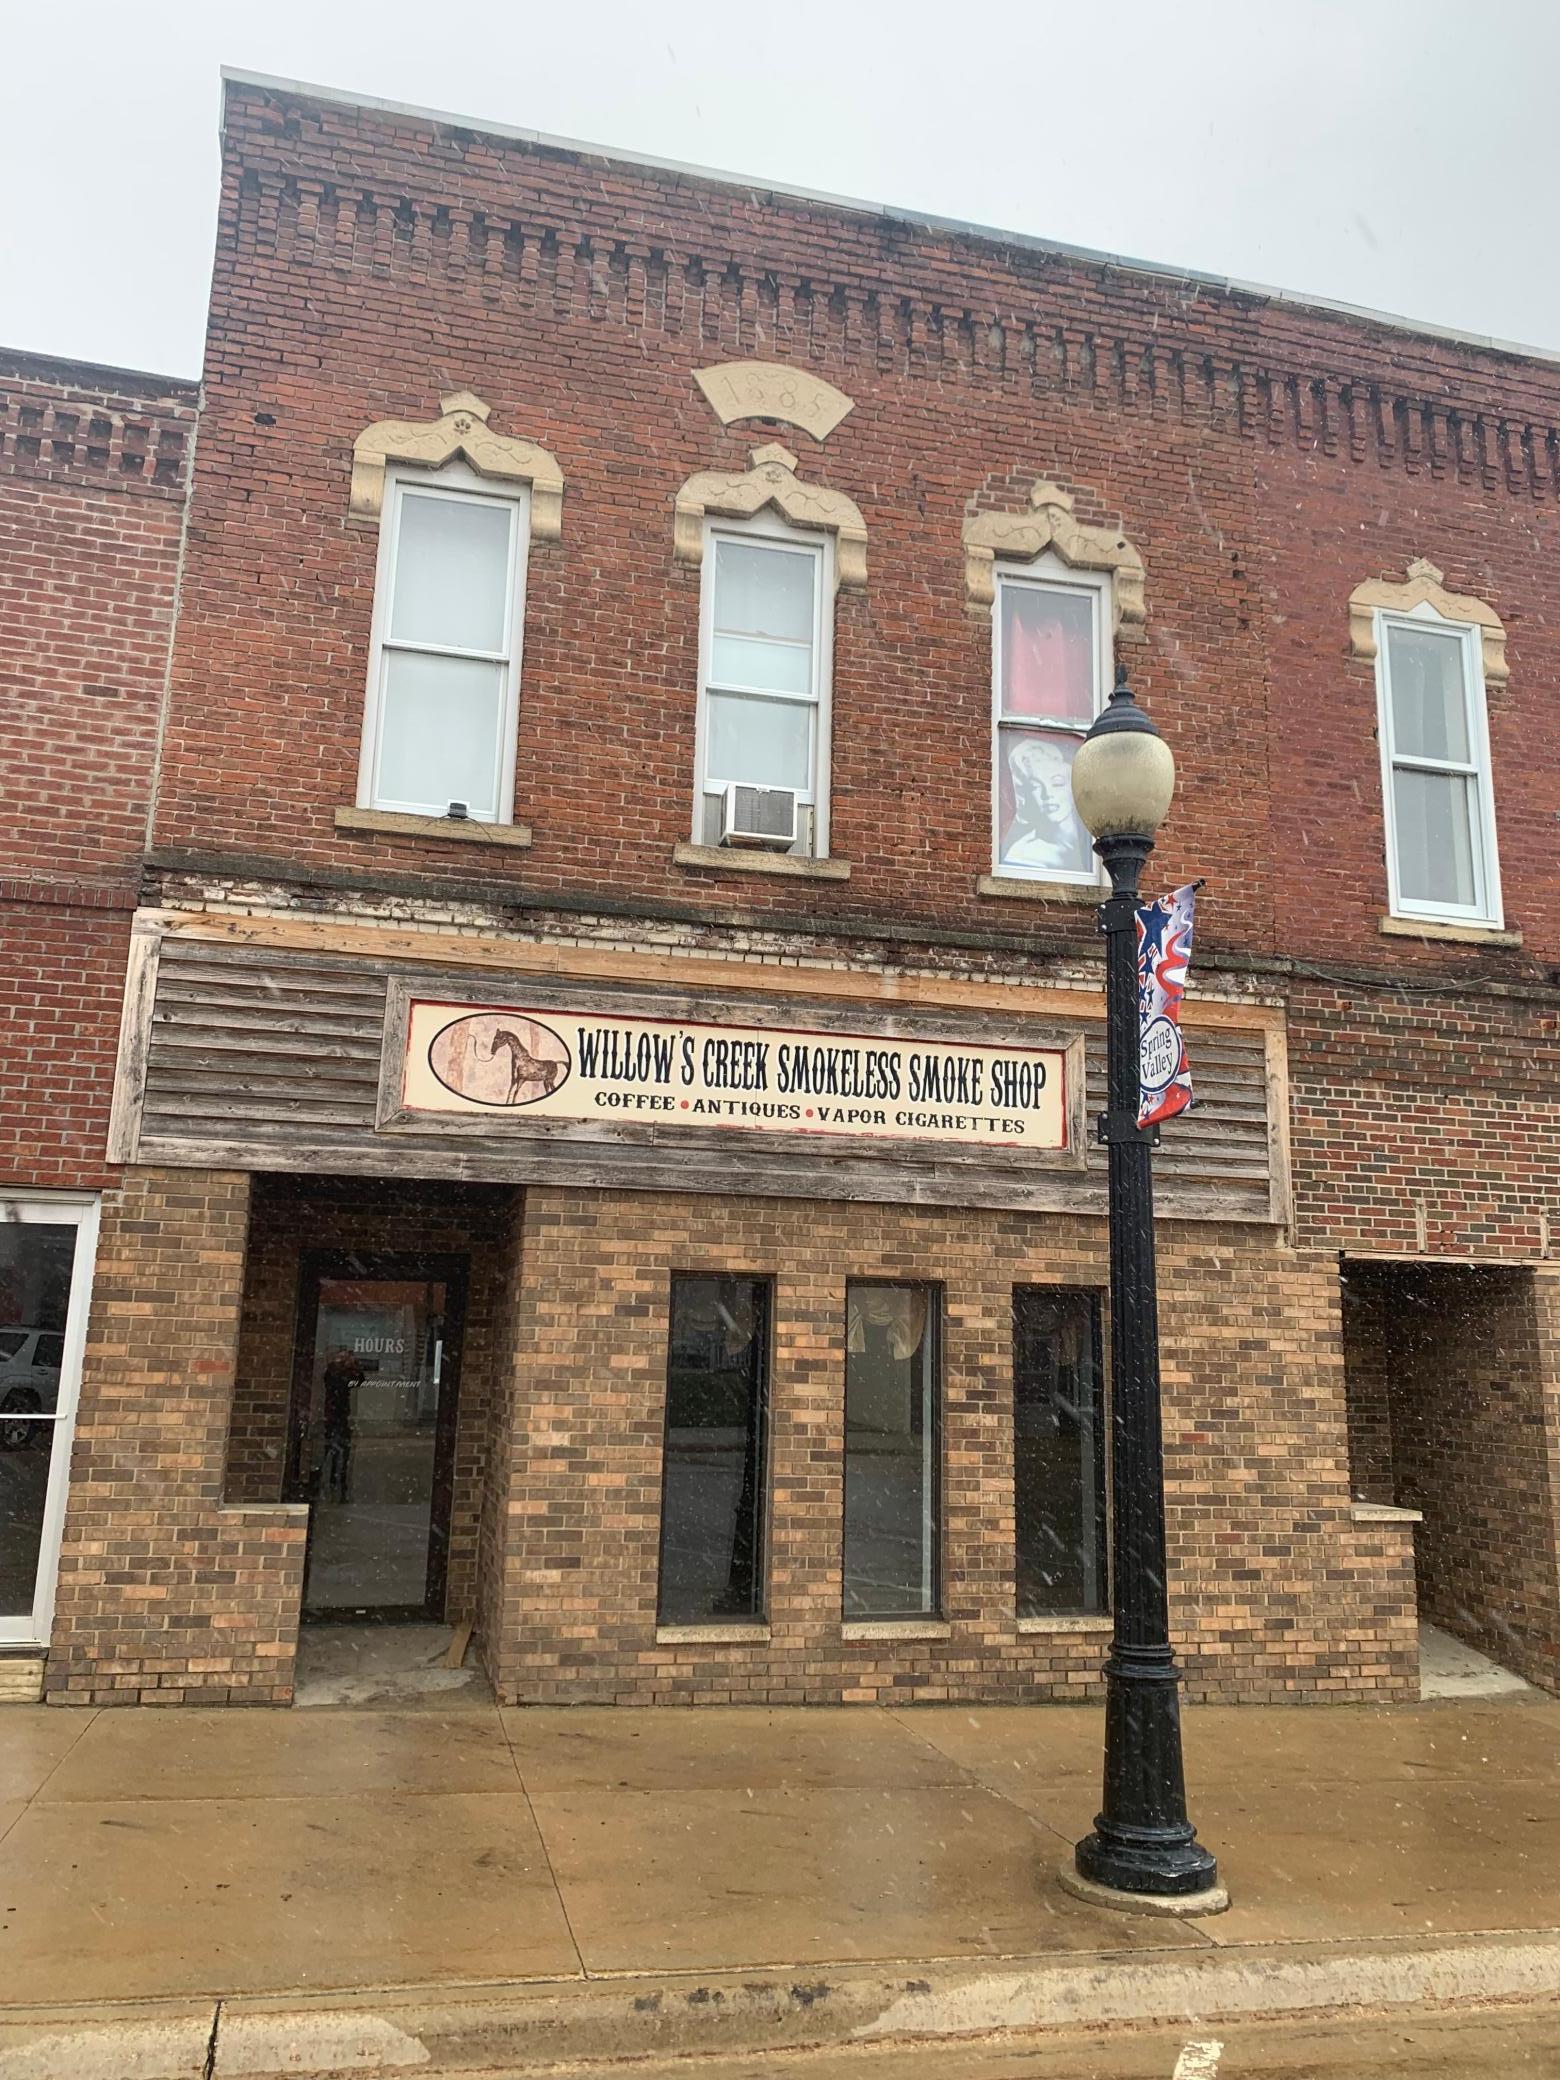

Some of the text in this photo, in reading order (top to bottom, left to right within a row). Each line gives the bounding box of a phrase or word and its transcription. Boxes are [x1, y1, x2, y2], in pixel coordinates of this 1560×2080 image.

[721, 373, 825, 418] 1885
[1141, 1027, 1172, 1060] Spring
[577, 1027, 1046, 1109] WILLOW'S CREEK SMOKELESS SMOKE SHOP
[1142, 1052, 1173, 1079] Valley
[594, 1091, 1025, 1134] COFFEE ANTIQUES VAPOR CIGARETTES
[353, 1337, 405, 1353] HOURS
